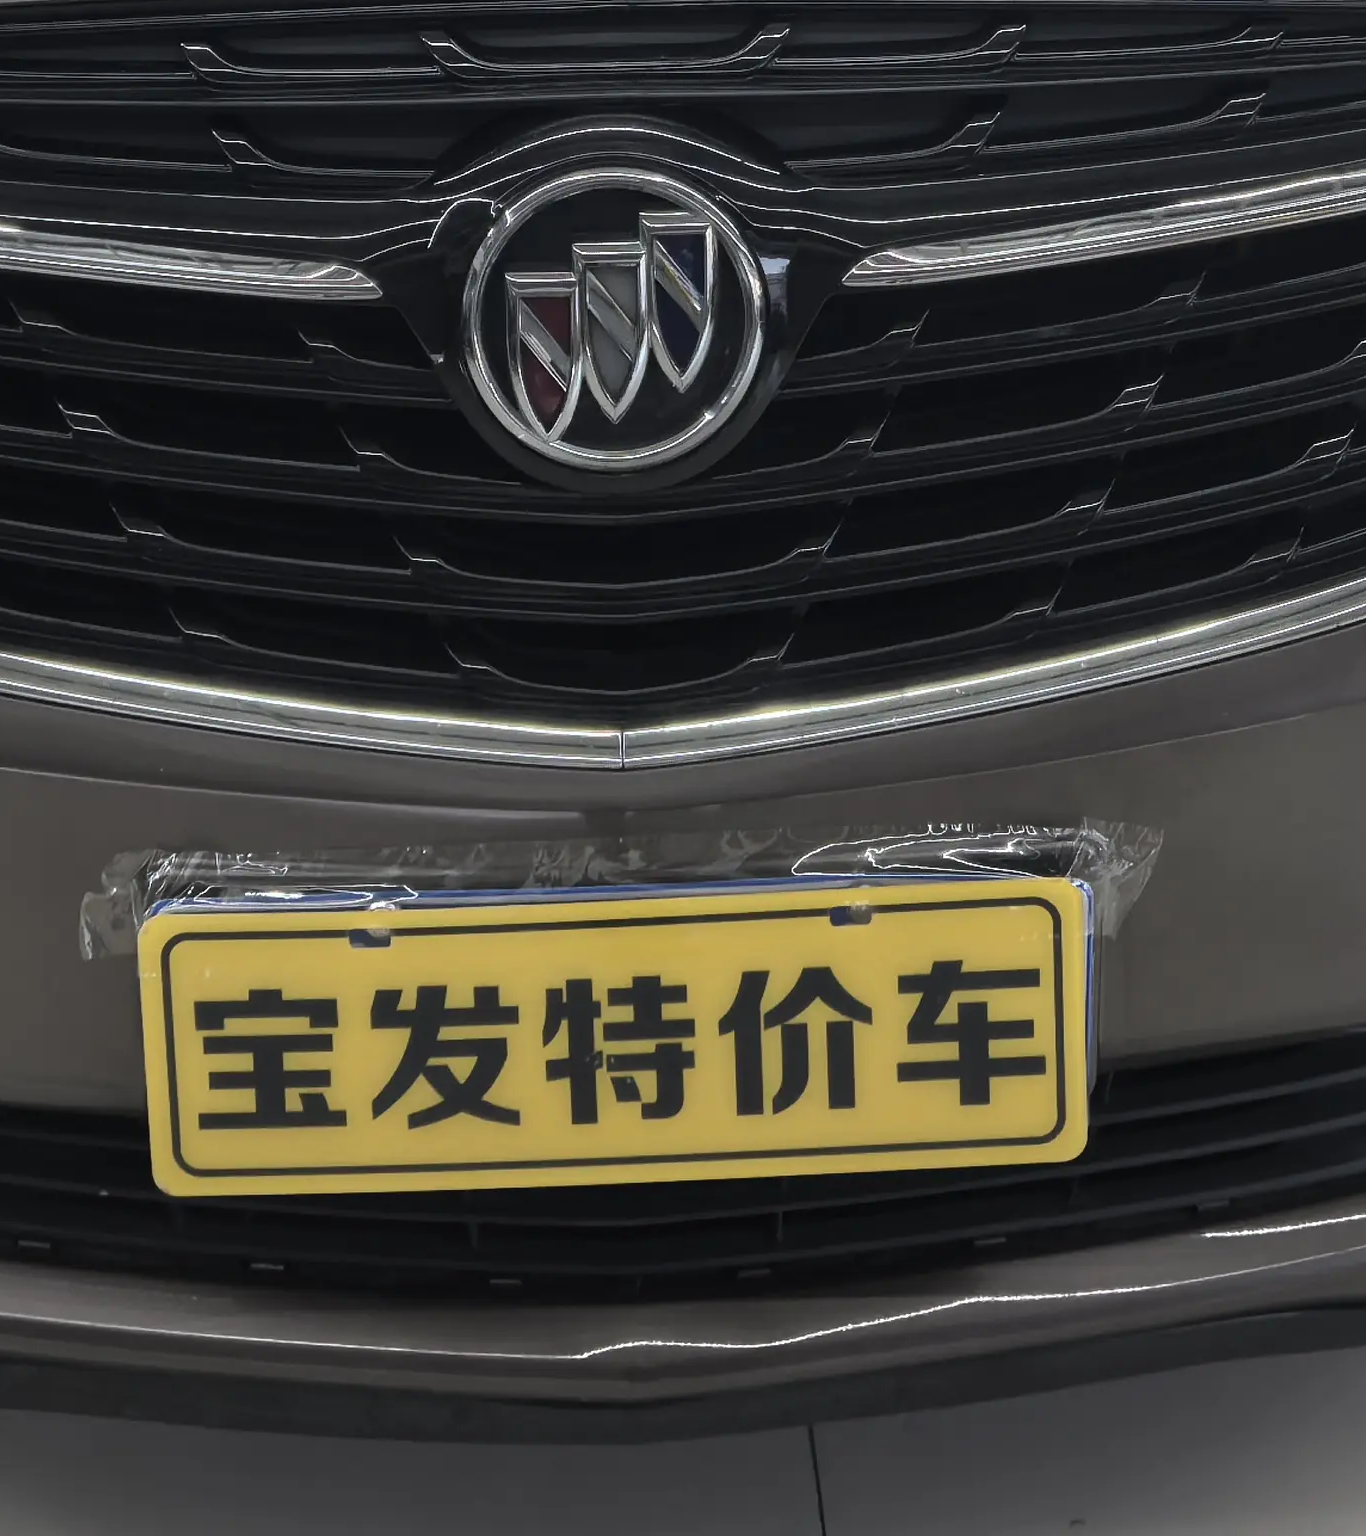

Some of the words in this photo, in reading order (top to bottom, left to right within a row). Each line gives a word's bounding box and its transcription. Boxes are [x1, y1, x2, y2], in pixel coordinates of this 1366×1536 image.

[193, 959, 1046, 1131] 宝发特价车
